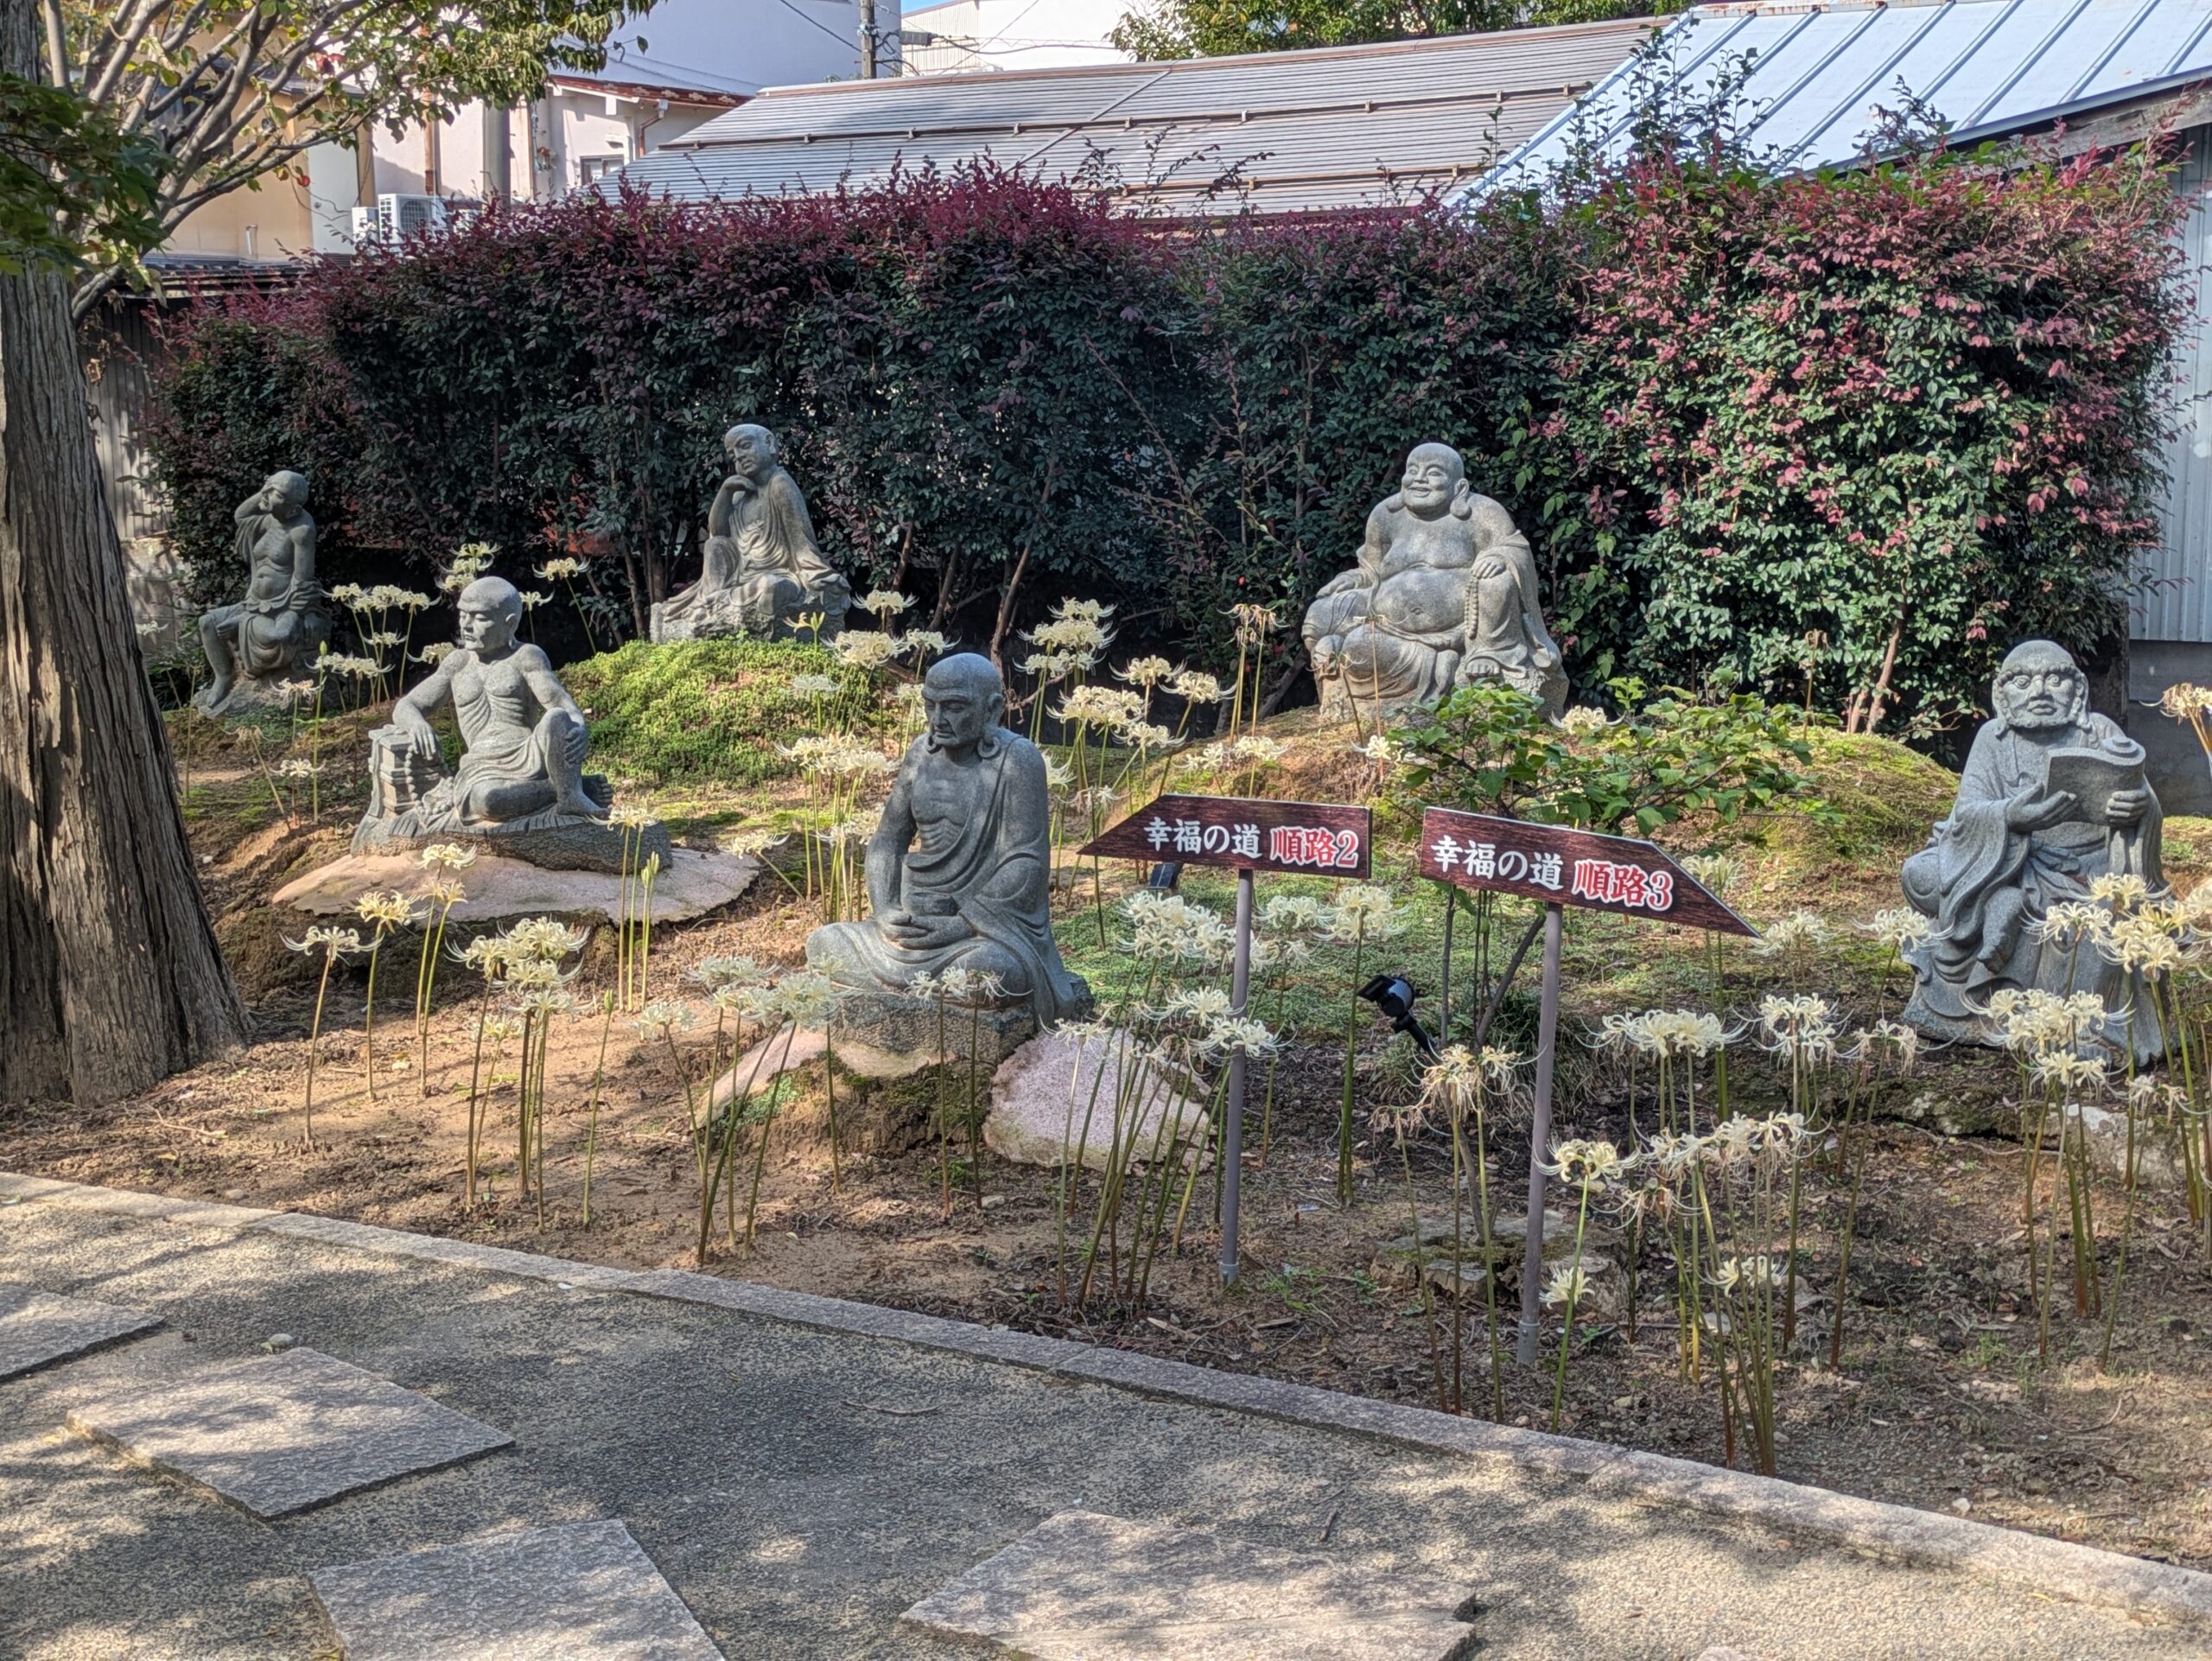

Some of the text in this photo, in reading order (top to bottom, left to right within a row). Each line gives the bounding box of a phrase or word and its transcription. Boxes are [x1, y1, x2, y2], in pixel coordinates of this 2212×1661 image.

[1143, 816, 1358, 868] 幸福の道 順路2
[1431, 835, 1674, 911] 幸福の道 順路3
